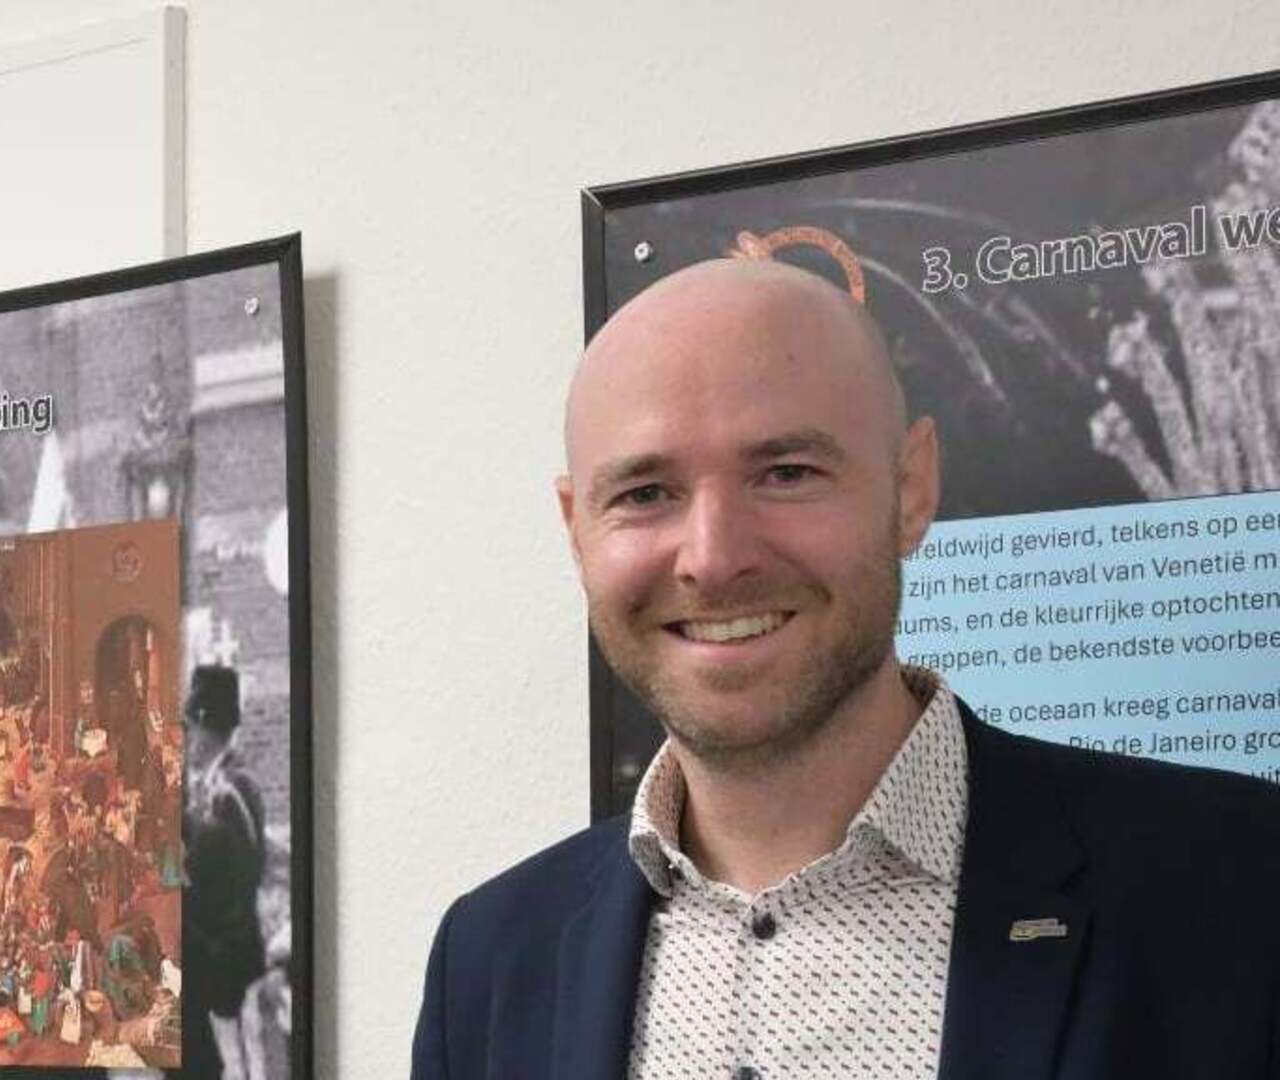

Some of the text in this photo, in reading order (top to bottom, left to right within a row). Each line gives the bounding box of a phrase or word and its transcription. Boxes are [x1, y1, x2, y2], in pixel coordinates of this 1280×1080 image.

[922, 248, 968, 293] 3.
[976, 205, 1206, 284] Carnaval
[1010, 523, 1103, 557] gevierd,
[1109, 518, 1200, 544] telkens
[1205, 515, 1238, 540] op
[908, 548, 1247, 602] zijn het carnaval van Venetië
[965, 611, 994, 632] en
[999, 606, 1029, 629] de
[1034, 598, 1145, 627] kleurrijke
[1012, 642, 1043, 665] de
[1048, 634, 1175, 662] bekendste
[1180, 629, 1280, 656] voorbee
[1008, 701, 1096, 724] oceaan
[1102, 695, 1171, 721] kreeg
[1113, 735, 1142, 754] de
[1150, 727, 1237, 753] Janeiro
